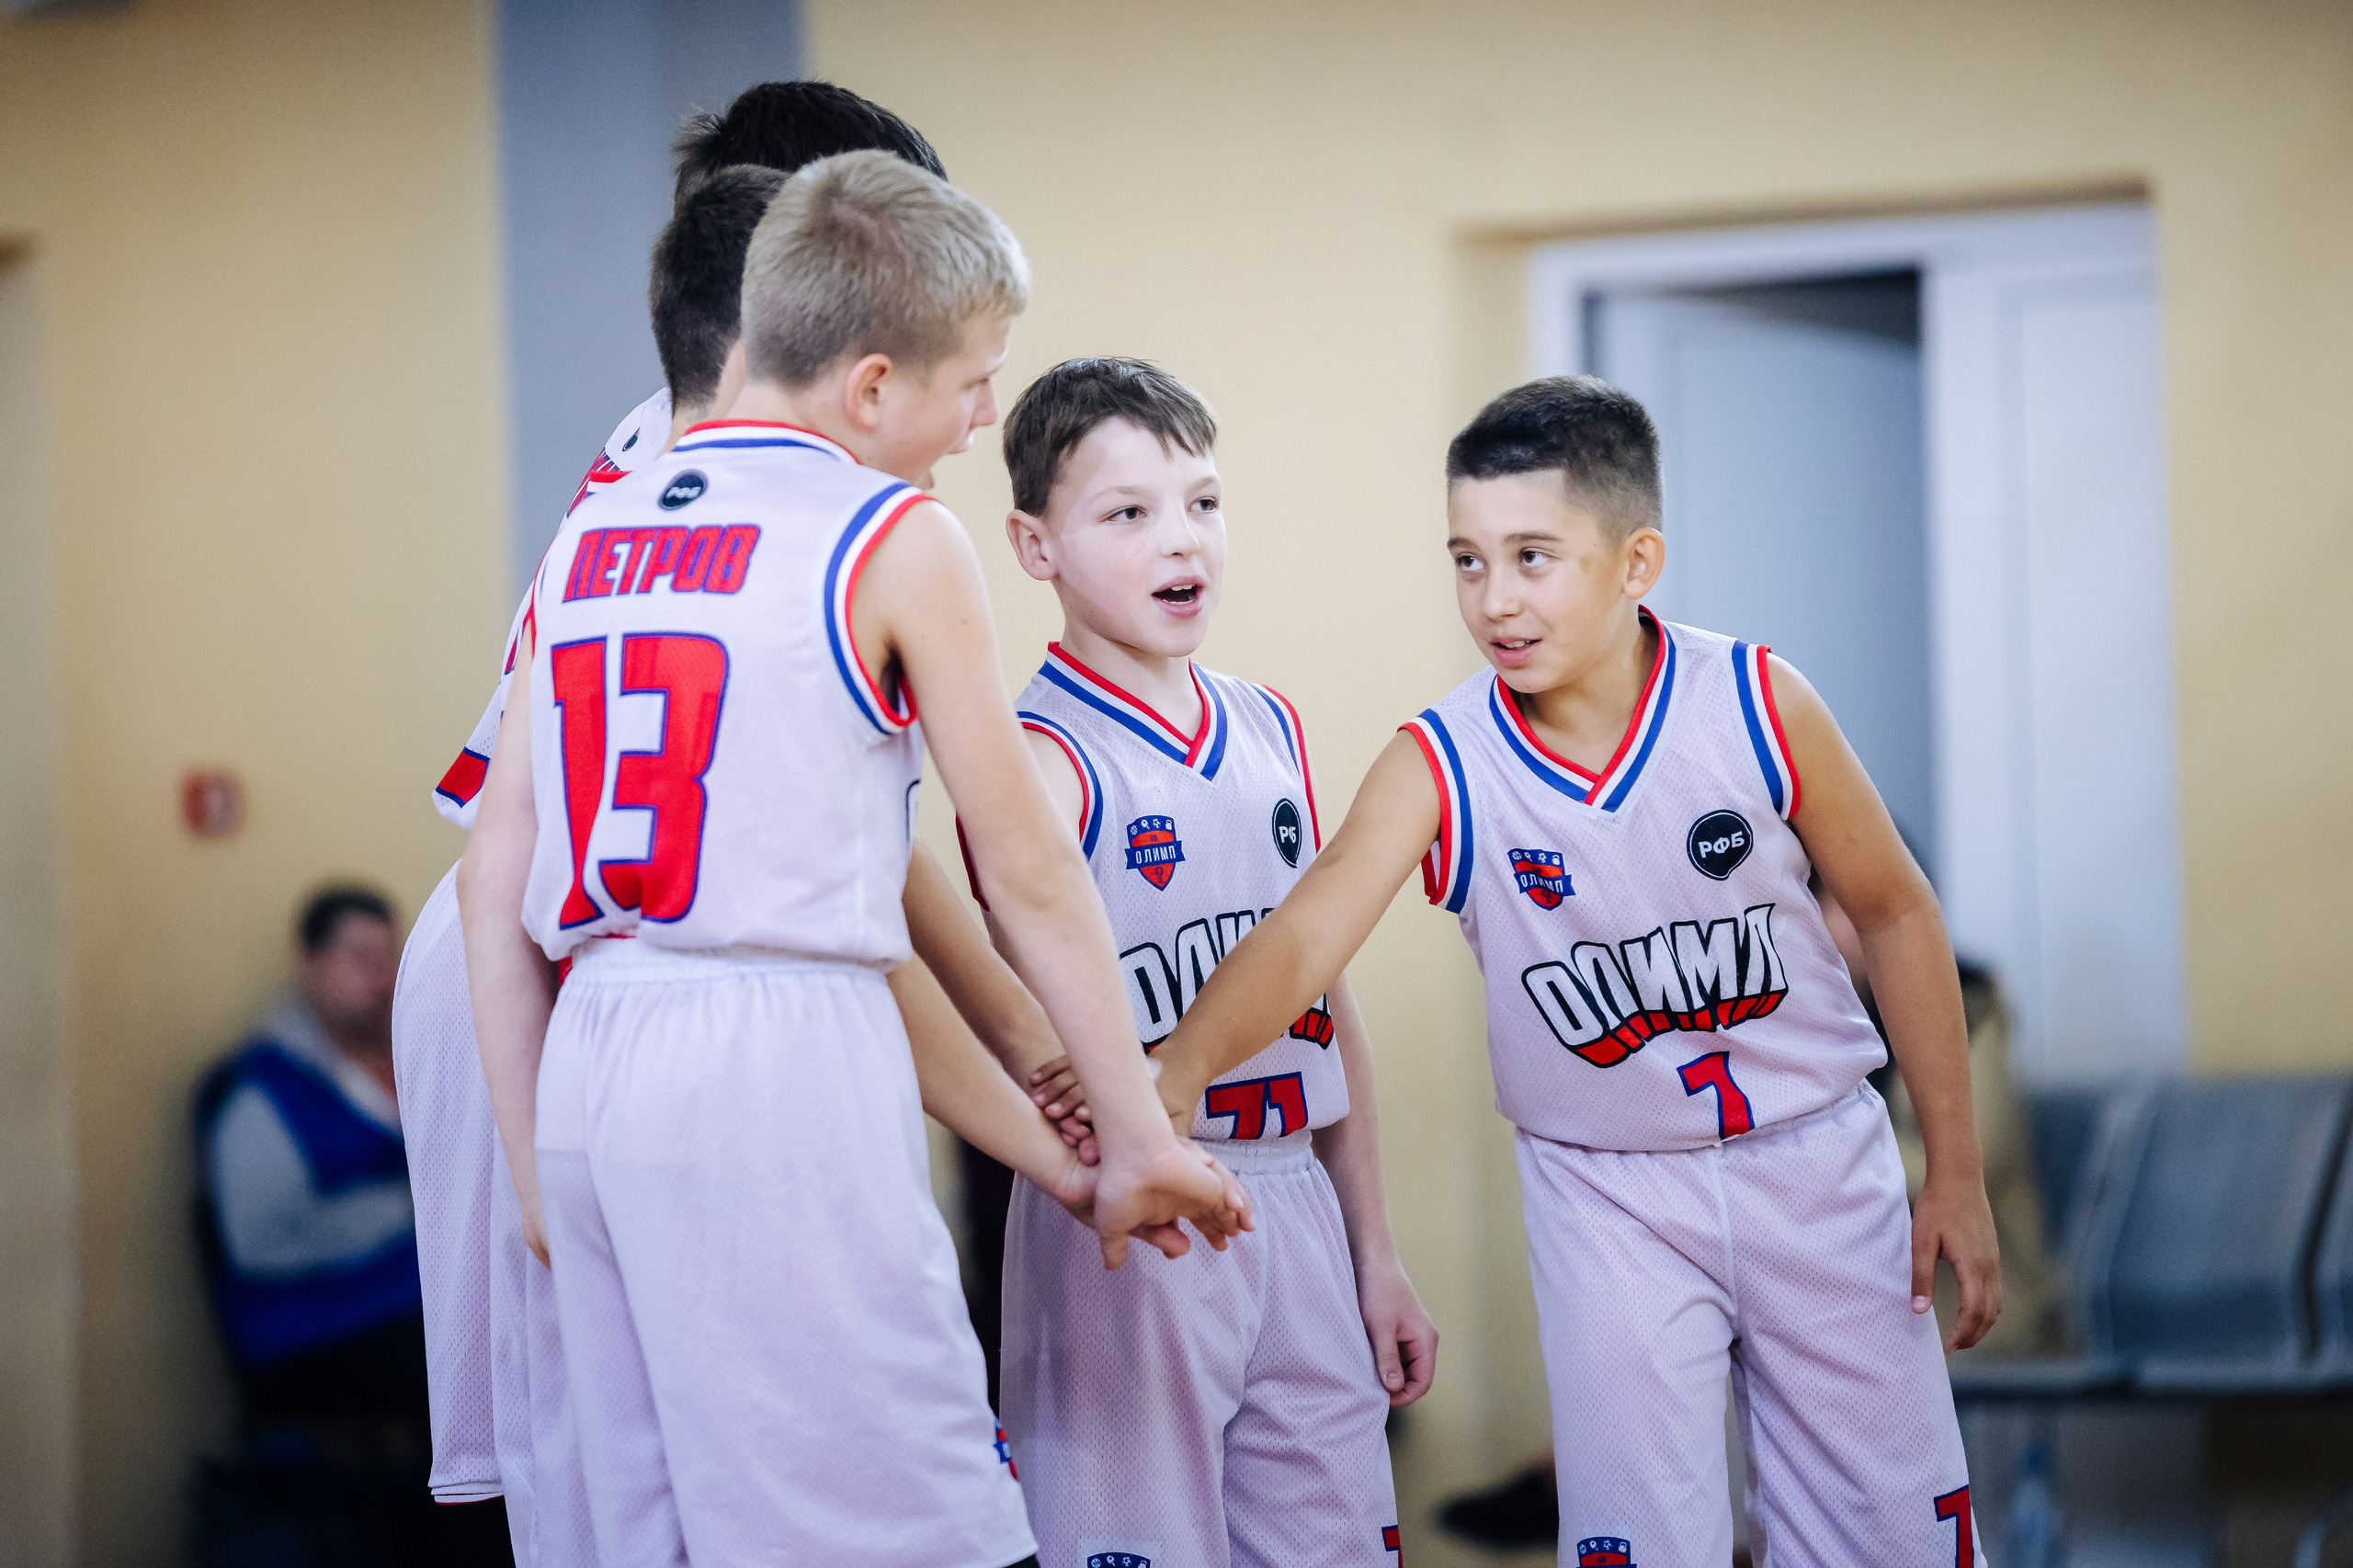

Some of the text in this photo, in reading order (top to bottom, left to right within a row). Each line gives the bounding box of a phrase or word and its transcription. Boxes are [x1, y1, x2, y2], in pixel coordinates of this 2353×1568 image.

[562, 525, 761, 604] ПЕТРОВ
[551, 631, 730, 930] 13
[1135, 845, 1176, 864] ОЛИМП
[1698, 831, 1745, 858] РФБ
[1519, 874, 1563, 893] ОЛИМП
[1521, 903, 1789, 1068] ОЛИМП
[1204, 1071, 1309, 1141] 71
[1676, 1051, 1756, 1141] 7
